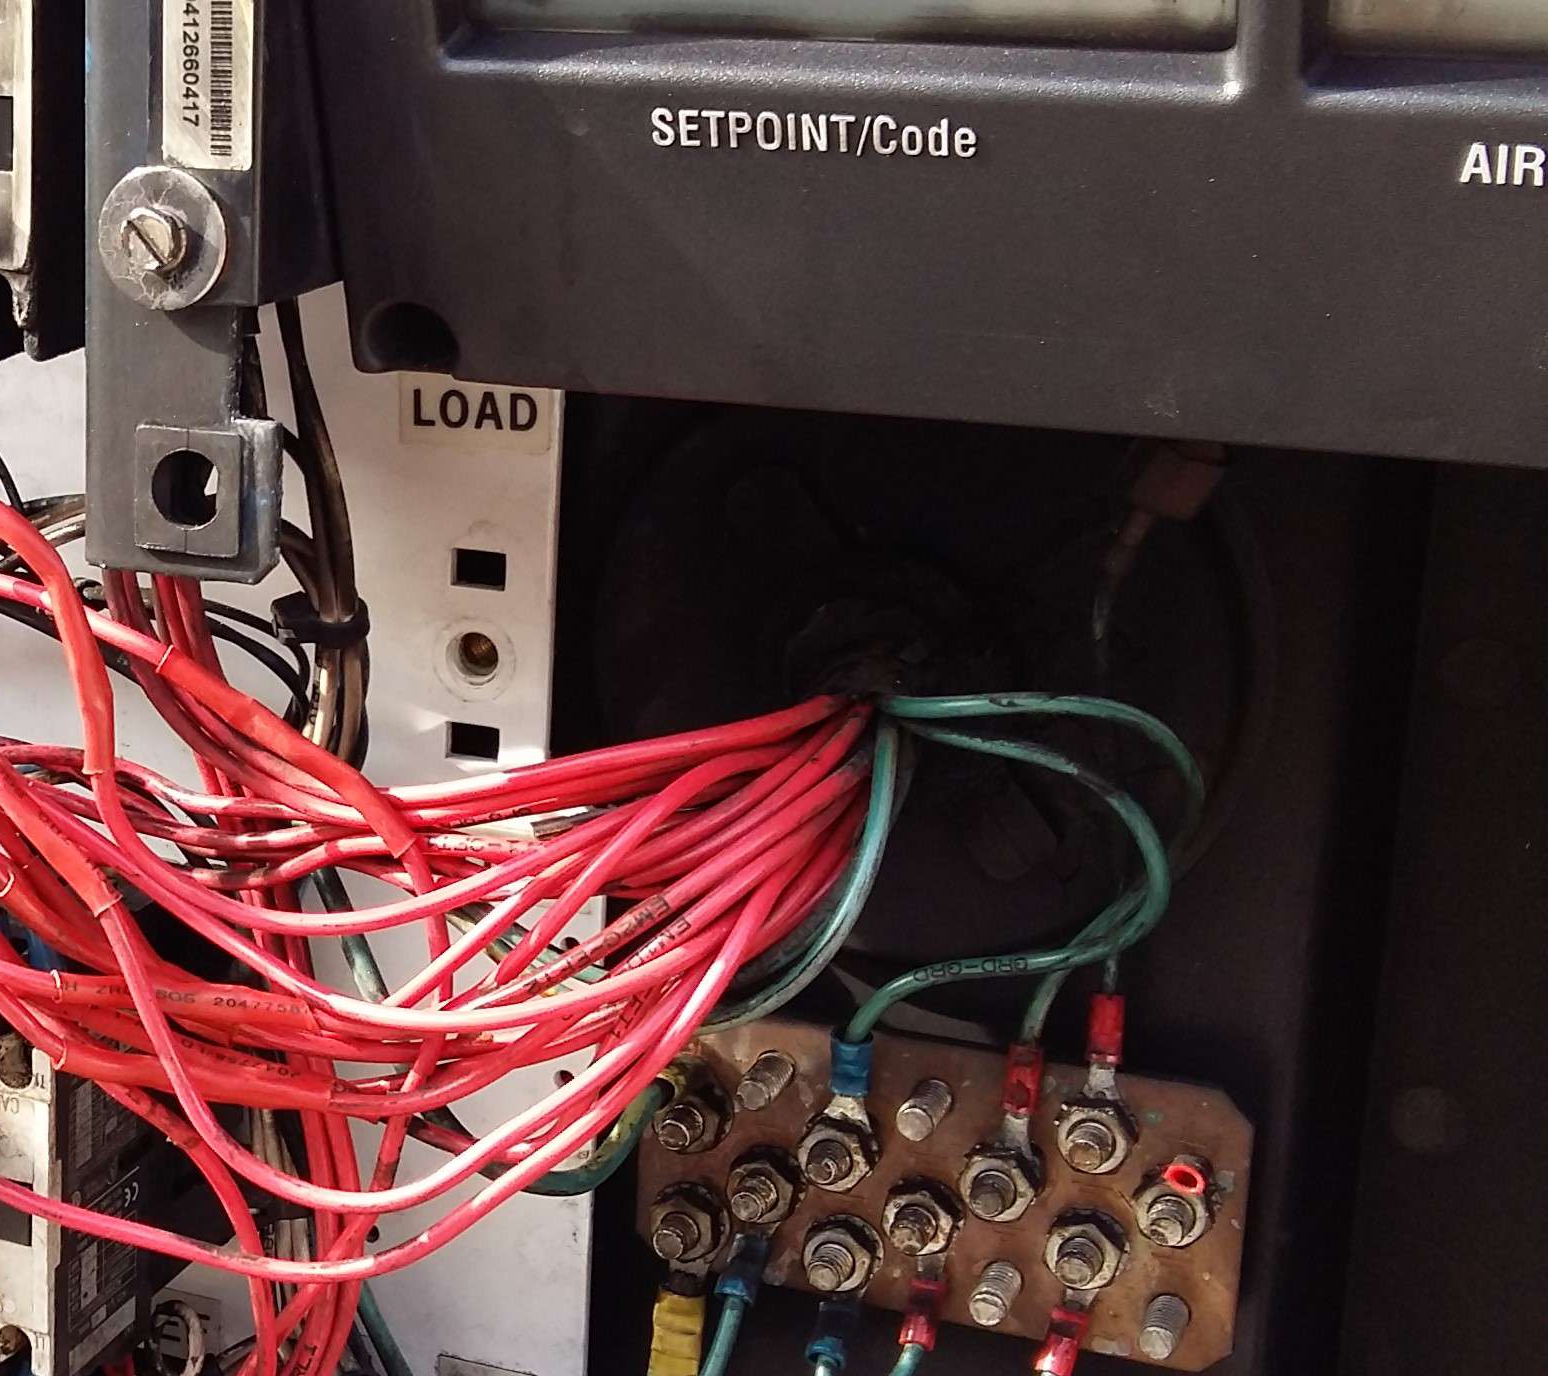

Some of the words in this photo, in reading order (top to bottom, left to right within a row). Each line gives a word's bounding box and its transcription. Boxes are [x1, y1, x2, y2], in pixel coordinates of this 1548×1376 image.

[650, 106, 977, 159] SETPOINT/Code
[1459, 142, 1547, 187] AIR
[413, 388, 538, 432] LOAD
